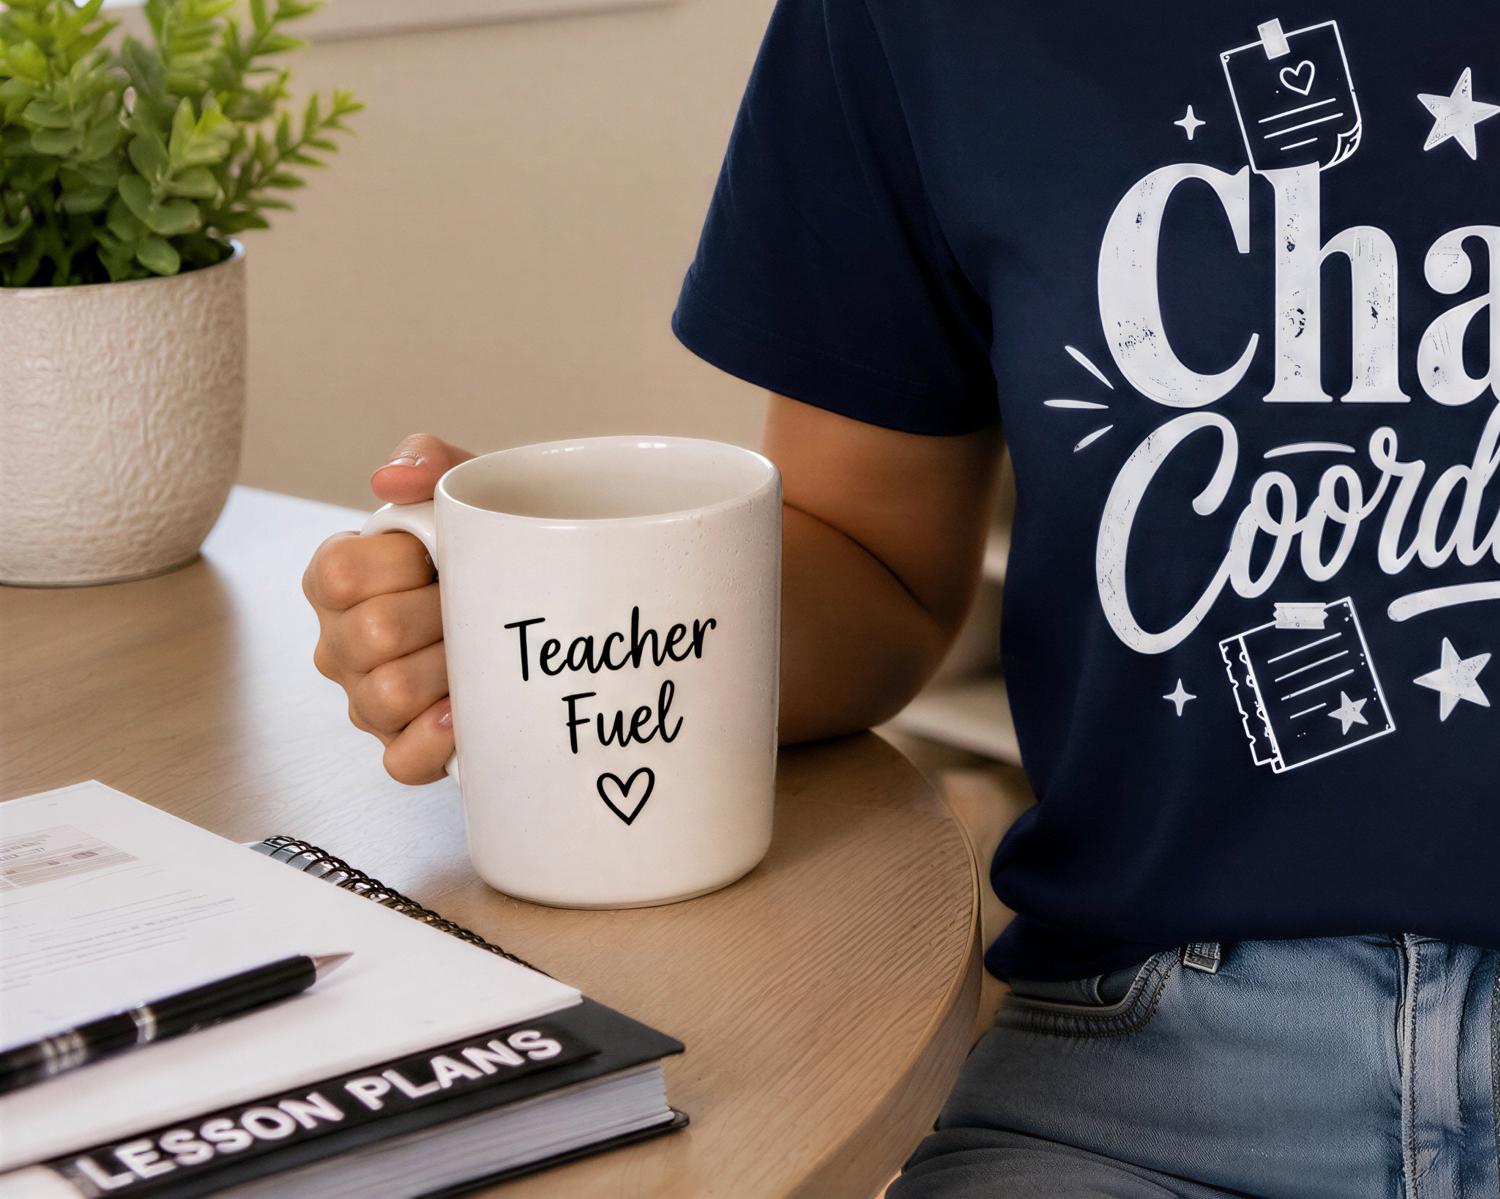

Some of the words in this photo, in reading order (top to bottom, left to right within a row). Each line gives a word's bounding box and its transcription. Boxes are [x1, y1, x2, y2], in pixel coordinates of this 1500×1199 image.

[503, 605, 717, 682] Teacher
[561, 679, 684, 755] Fuel
[75, 1091, 345, 1191] LESSON
[344, 1029, 563, 1112] PLANS
